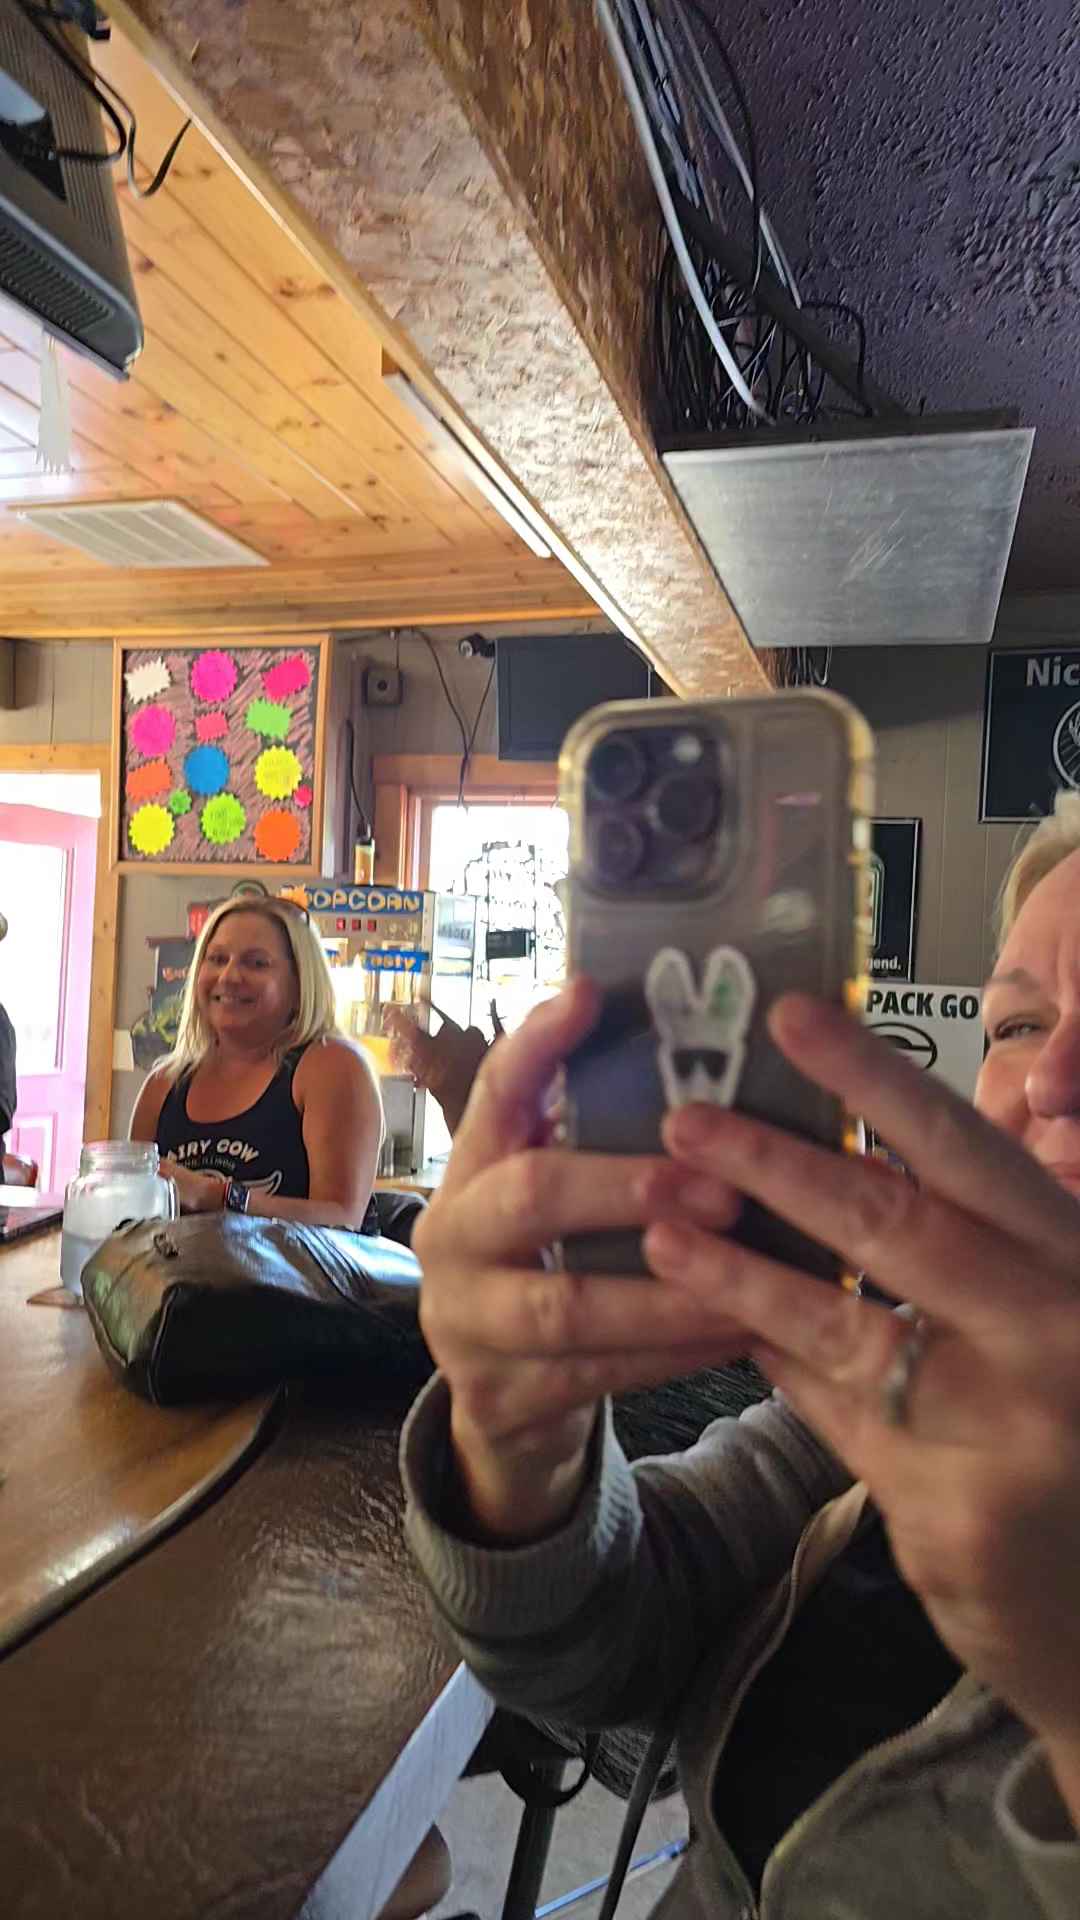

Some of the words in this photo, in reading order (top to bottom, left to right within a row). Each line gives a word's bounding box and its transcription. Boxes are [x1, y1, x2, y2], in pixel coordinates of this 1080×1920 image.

[865, 989, 934, 1016] PACK
[940, 994, 980, 1019] GO
[216, 1138, 259, 1163] COW
